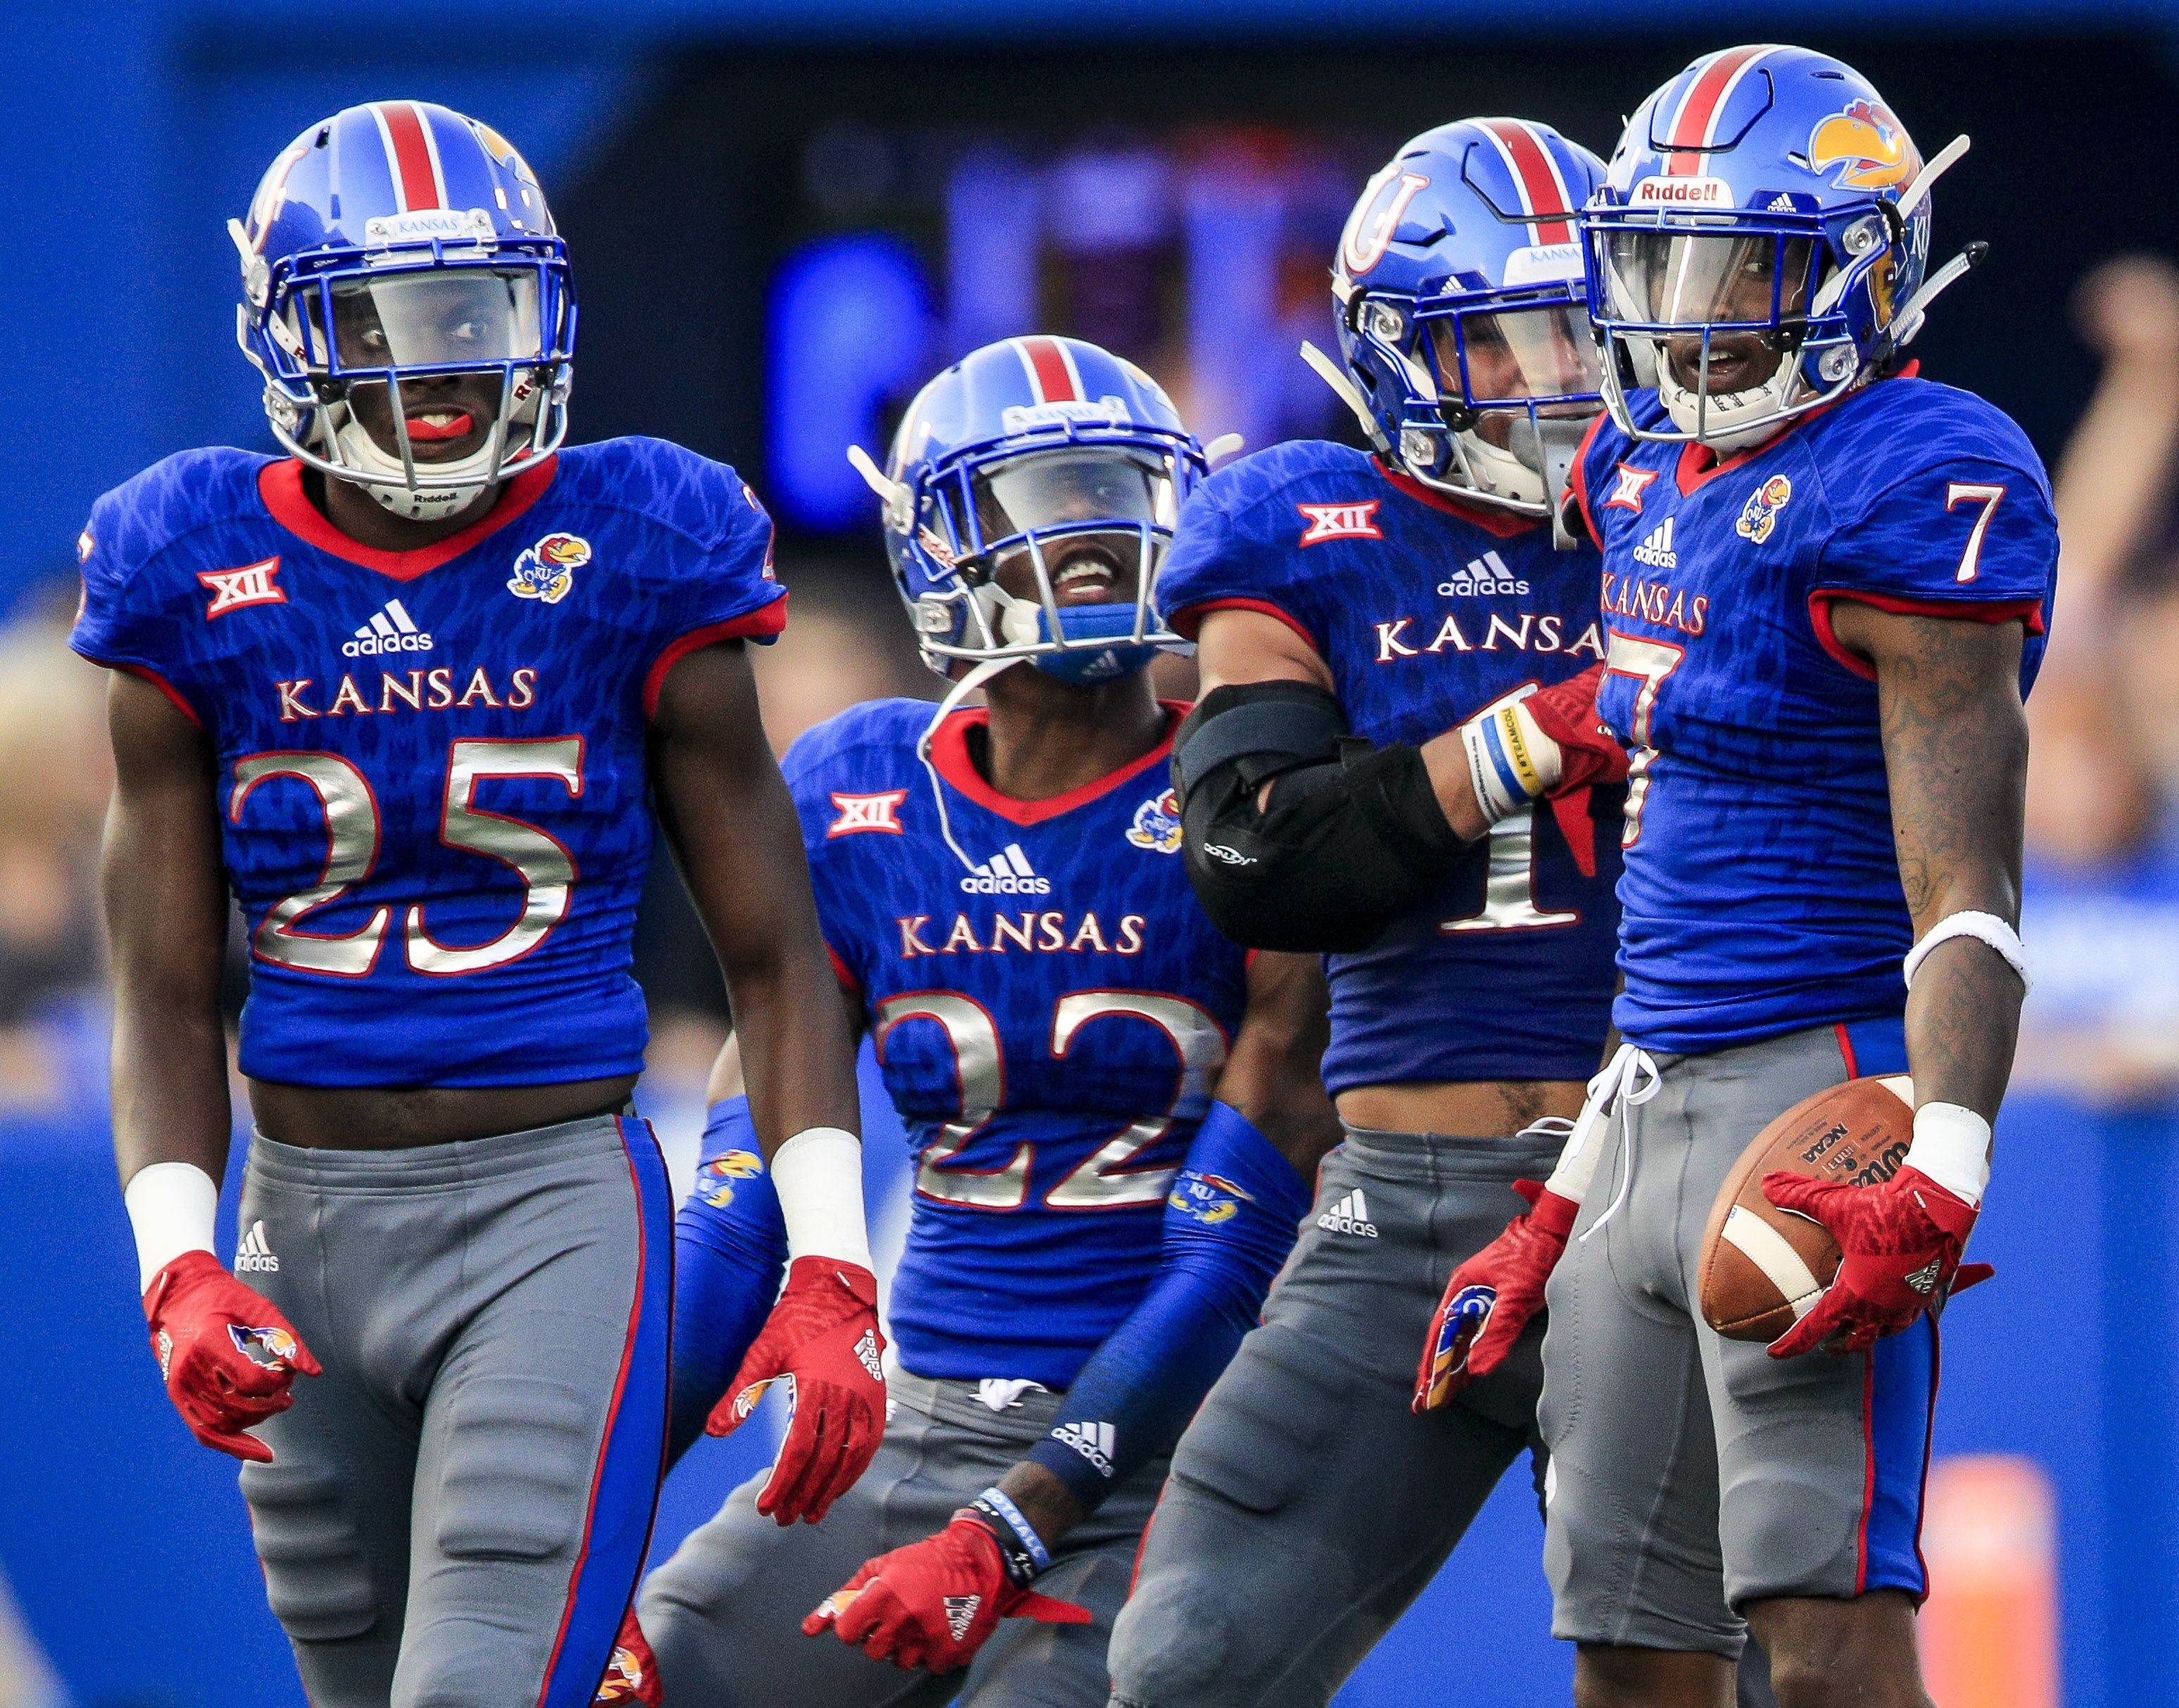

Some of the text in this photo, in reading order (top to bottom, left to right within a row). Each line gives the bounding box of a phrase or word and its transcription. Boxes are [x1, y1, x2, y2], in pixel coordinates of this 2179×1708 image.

[1642, 184, 1717, 201] Riddell
[399, 218, 457, 234] KANSAS
[1530, 247, 1583, 263] KANSA
[414, 493, 457, 504] Riddell
[1947, 482, 2006, 583] 7
[1633, 546, 1677, 569] adidas
[1436, 576, 1530, 597] adidas
[1599, 571, 1709, 636] KANSAS
[342, 628, 433, 657] adidas
[1375, 614, 1606, 664] KANSA
[275, 667, 537, 721] KANSAS
[1596, 628, 1684, 848] 7
[230, 733, 585, 977] 25
[960, 873, 1051, 896] adidas
[898, 911, 1147, 958] KANSAS
[874, 989, 1232, 1213] 22
[1801, 1122, 1848, 1164] NCAA
[1317, 1213, 1379, 1239] adidas
[234, 1253, 279, 1272] adidas
[1051, 1427, 1115, 1477] adidas
